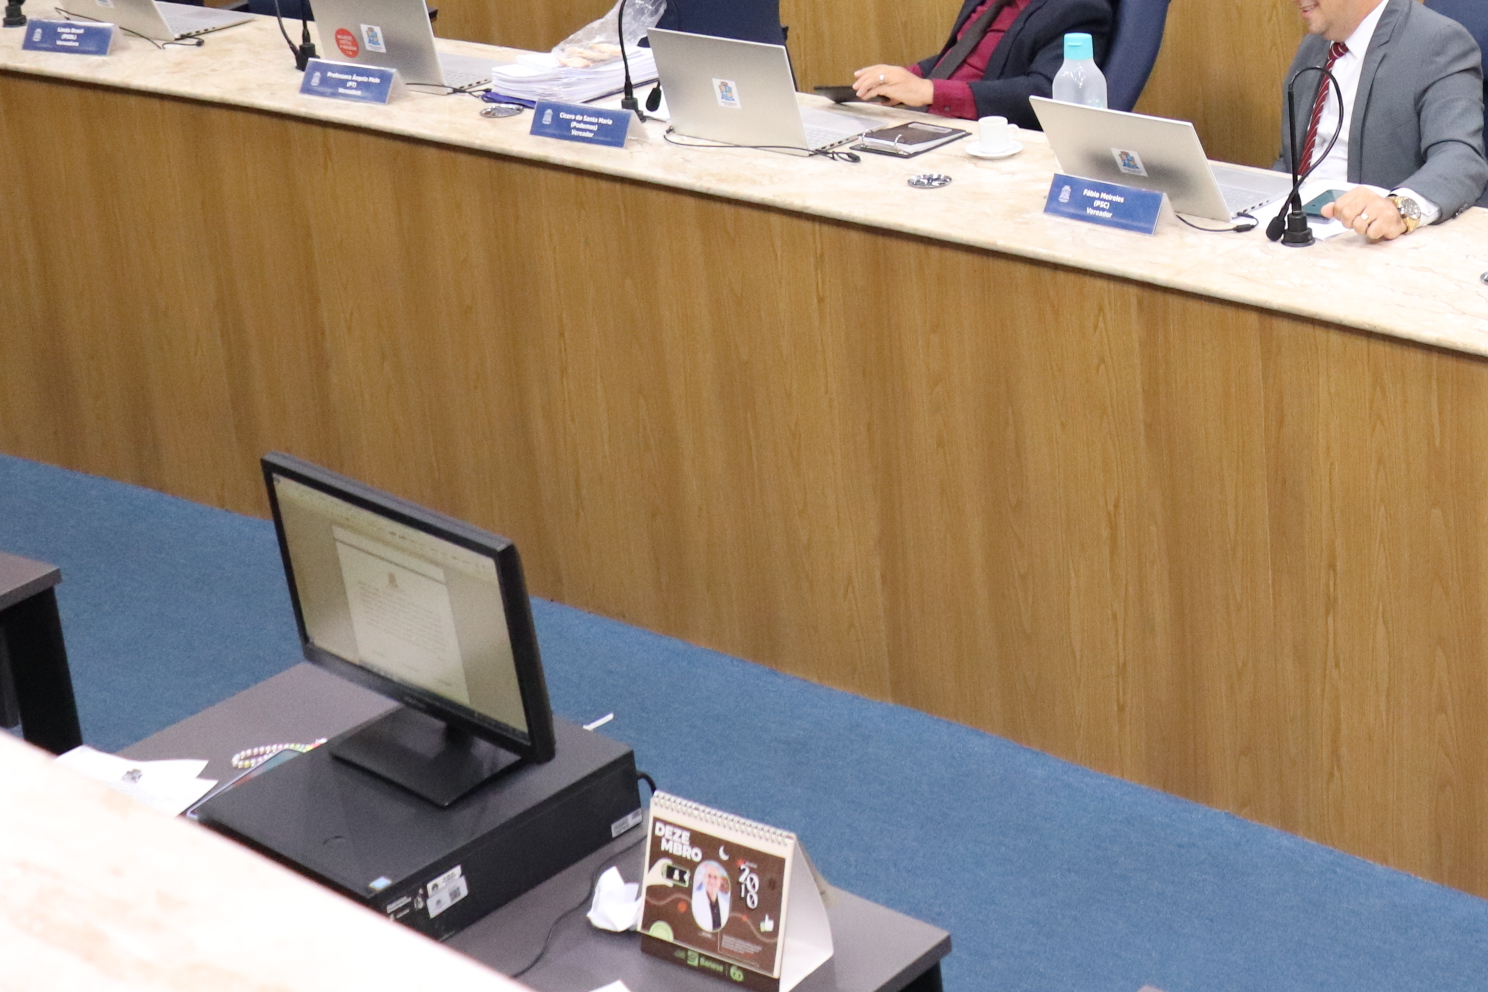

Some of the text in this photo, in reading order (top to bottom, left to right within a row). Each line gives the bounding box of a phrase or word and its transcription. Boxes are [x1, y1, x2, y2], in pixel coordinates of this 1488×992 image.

[582, 114, 599, 124] Santa
[598, 116, 613, 126] Maria
[1082, 188, 1125, 204] Fábio Meireles
[1093, 199, 1110, 210] (PSC)
[1086, 206, 1113, 219] Vereador
[654, 820, 691, 846] DEZE
[660, 836, 703, 863] MBRO
